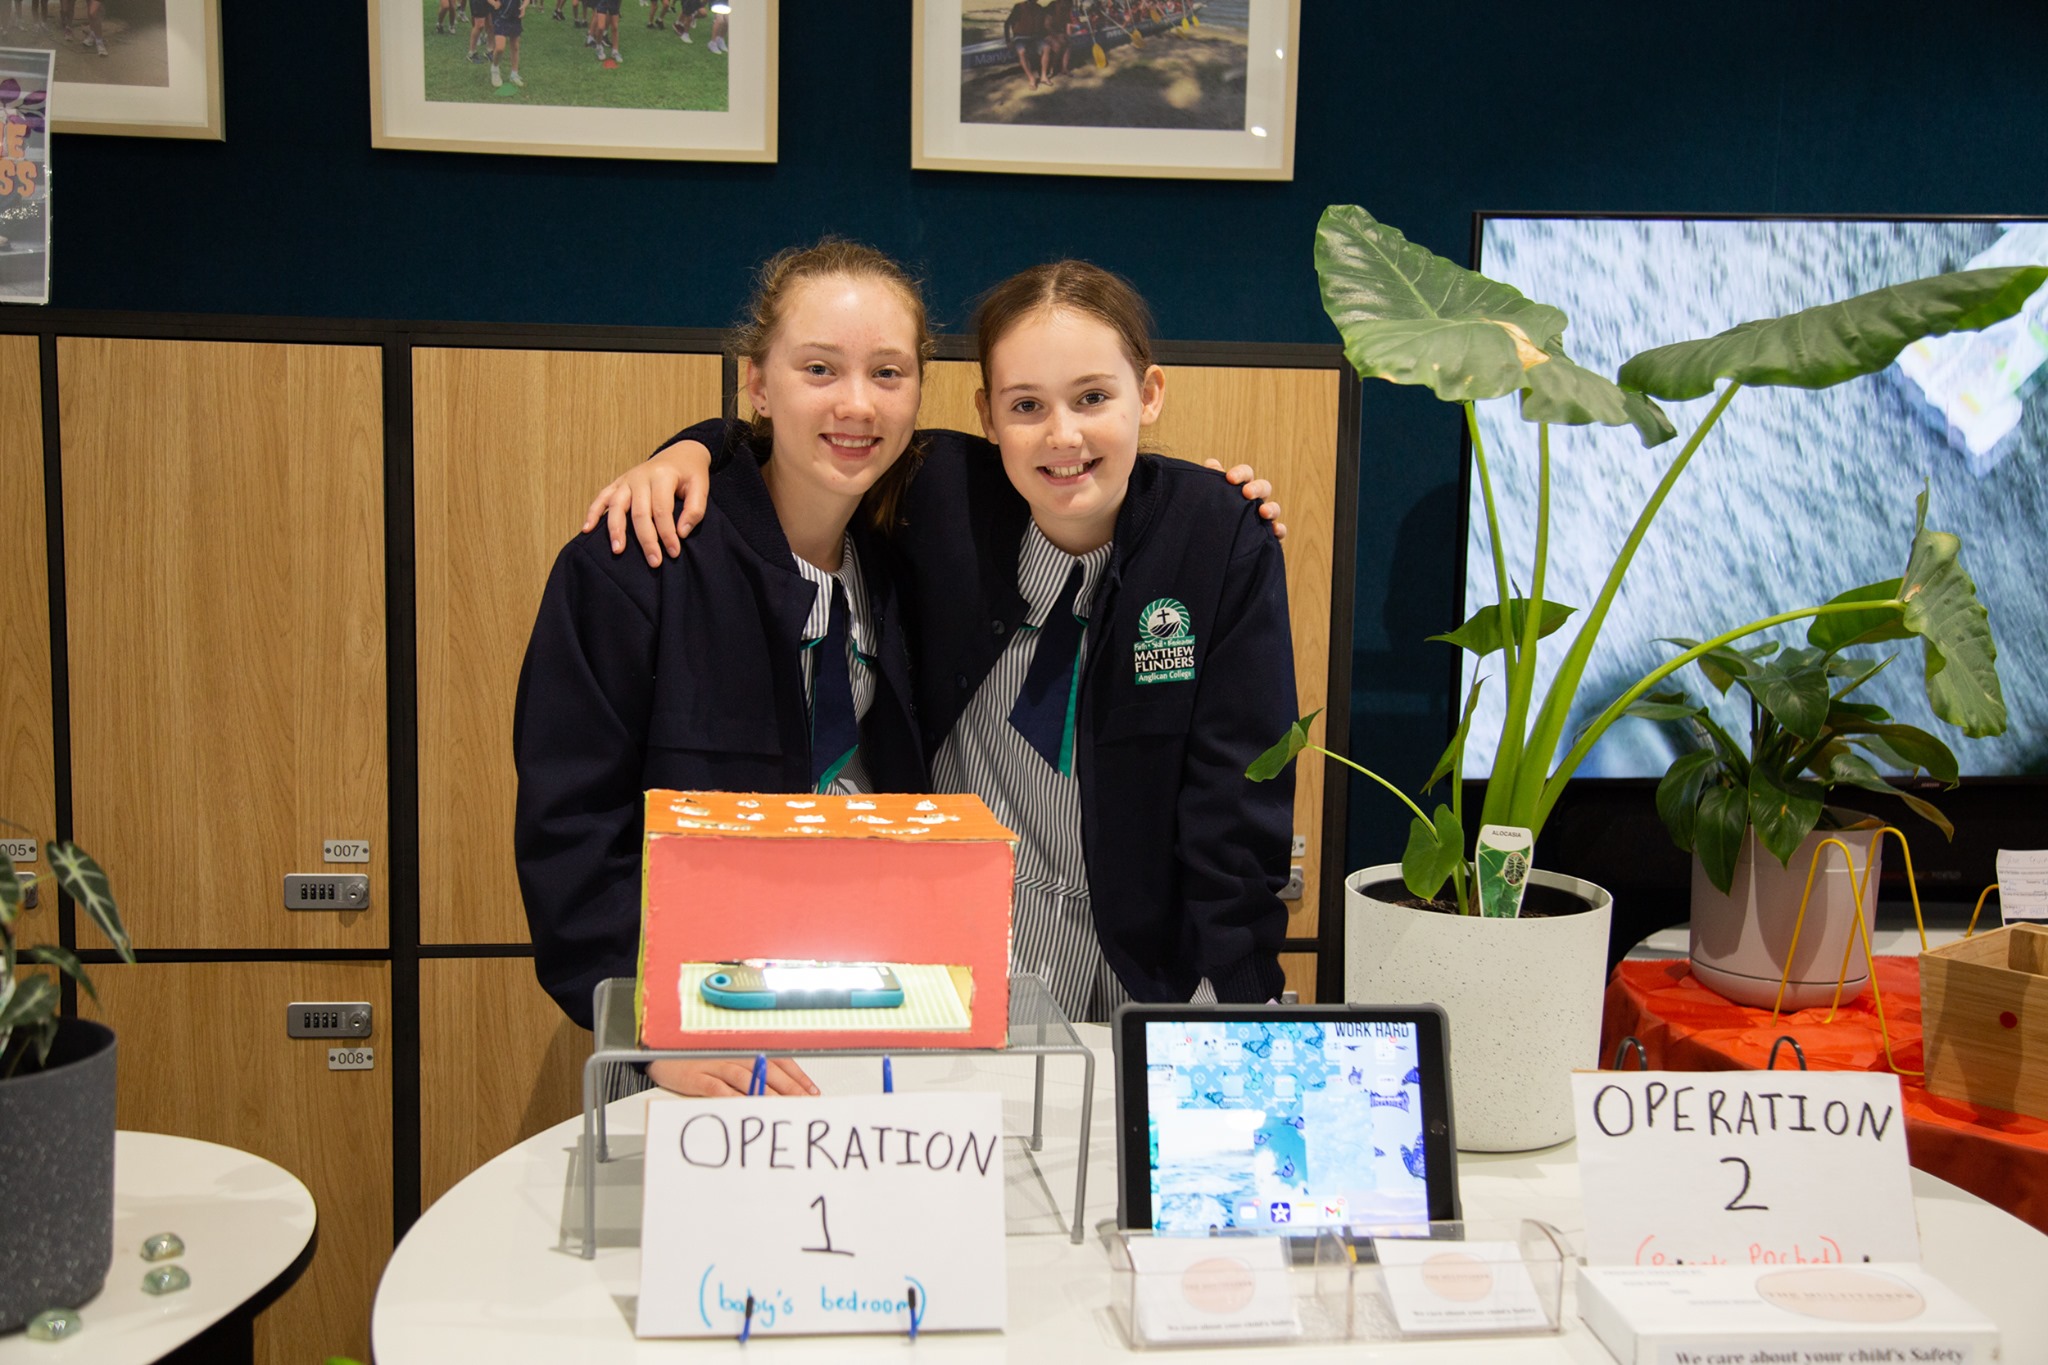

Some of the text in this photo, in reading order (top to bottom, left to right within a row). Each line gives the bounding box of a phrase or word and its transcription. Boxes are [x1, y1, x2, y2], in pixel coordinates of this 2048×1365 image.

[1134, 646, 1195, 662] MATTHEW
[1135, 656, 1195, 673] FLINDERS
[1138, 670, 1192, 683] Anglican College
[1491, 830, 1522, 838] ALOCASIA
[333, 844, 360, 857] 007
[1335, 1022, 1409, 1038] WORK HARD
[338, 1052, 364, 1065] 008
[1593, 1081, 1894, 1142] OPERATION
[680, 1113, 997, 1177] OPERATION
[1719, 1157, 1769, 1212] 2
[801, 1195, 855, 1257] 1
[1675, 1347, 1965, 1365] We care about your child's Safety
